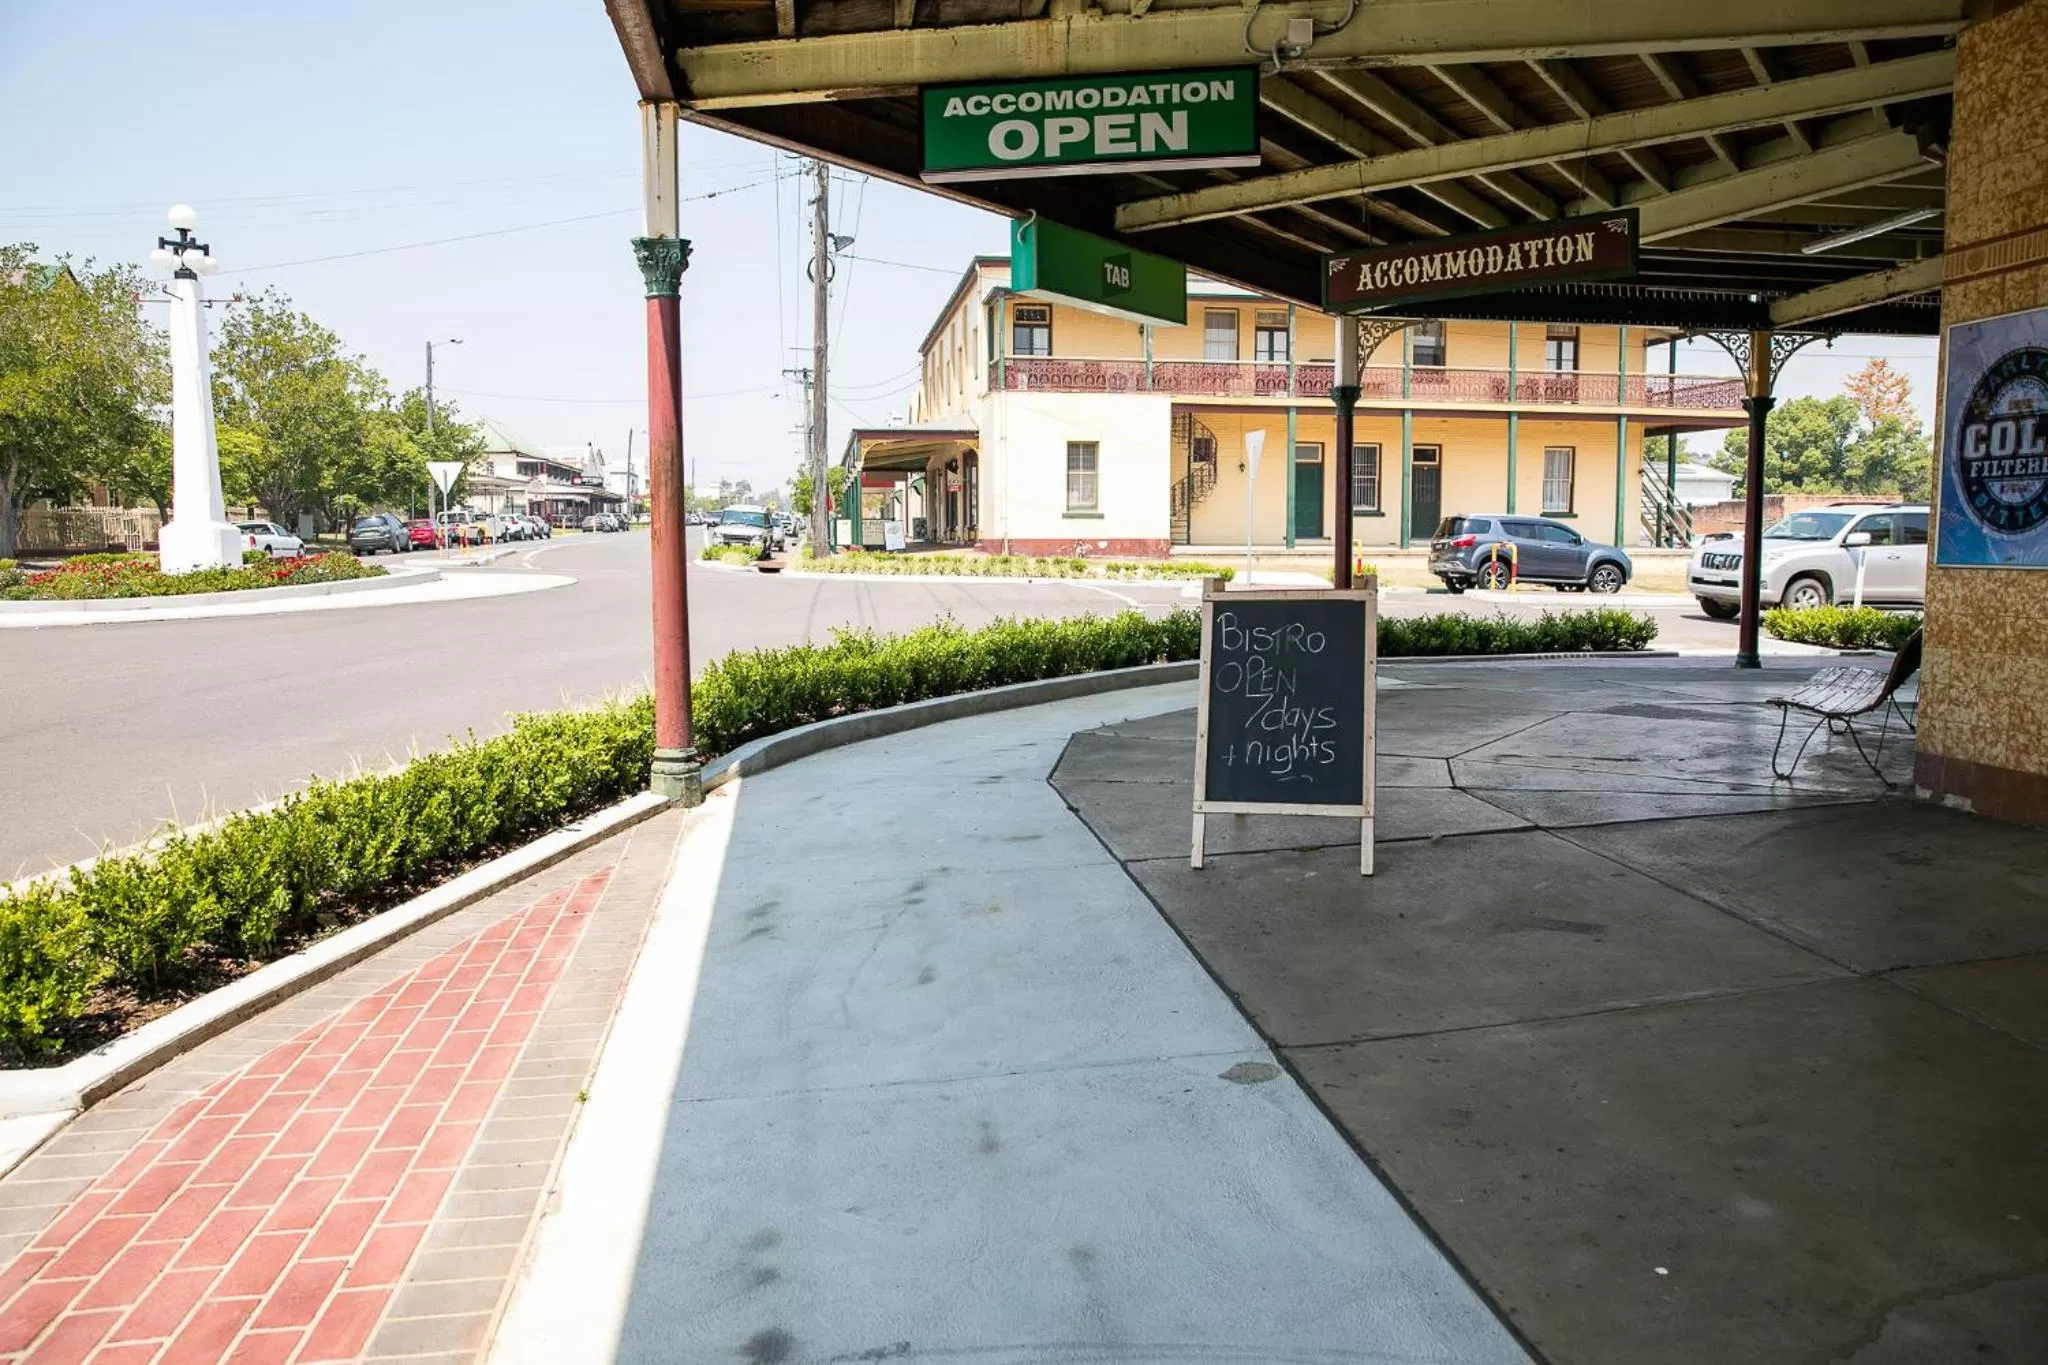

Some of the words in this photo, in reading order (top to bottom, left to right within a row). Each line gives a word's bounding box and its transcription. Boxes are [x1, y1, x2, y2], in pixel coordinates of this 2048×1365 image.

[943, 80, 1236, 117] ACCOMODATION
[988, 110, 1189, 161] OPEN
[1104, 262, 1130, 288] TAB
[1356, 232, 1596, 292] ACCOMMODATION
[1217, 612, 1326, 655] BISTRO
[1215, 655, 1297, 698] OPEN
[1245, 733, 1336, 775] nights
